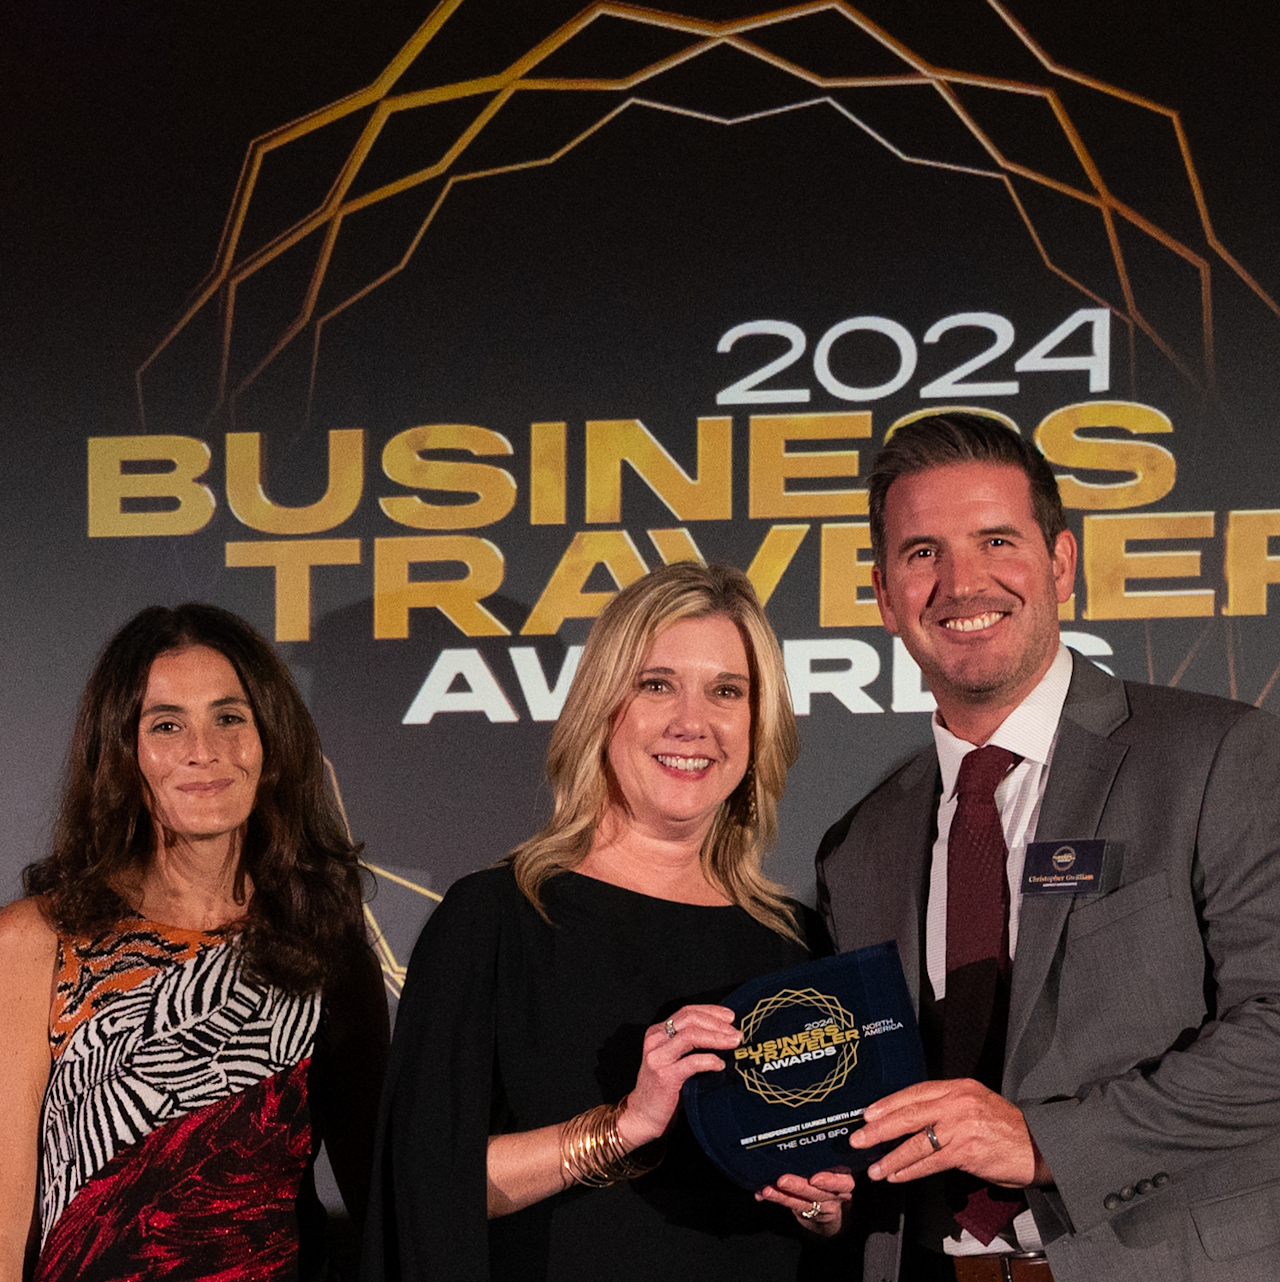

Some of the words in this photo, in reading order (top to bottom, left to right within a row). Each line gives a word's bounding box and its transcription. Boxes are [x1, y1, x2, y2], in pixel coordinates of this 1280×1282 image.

[715, 308, 1111, 404] 2024
[87, 402, 1177, 538] BUSINES
[804, 1017, 834, 1031] 2024
[862, 1018, 894, 1031] NORTH
[864, 1022, 904, 1038] AMERICA
[734, 1024, 840, 1060] BUSINESS
[749, 1029, 860, 1064] TRAVELER
[761, 1046, 837, 1073] AWARDS
[740, 1136, 758, 1145] BEST
[827, 1112, 849, 1123] NORTH
[777, 1140, 797, 1151] THE
[799, 1132, 826, 1146] CLUB
